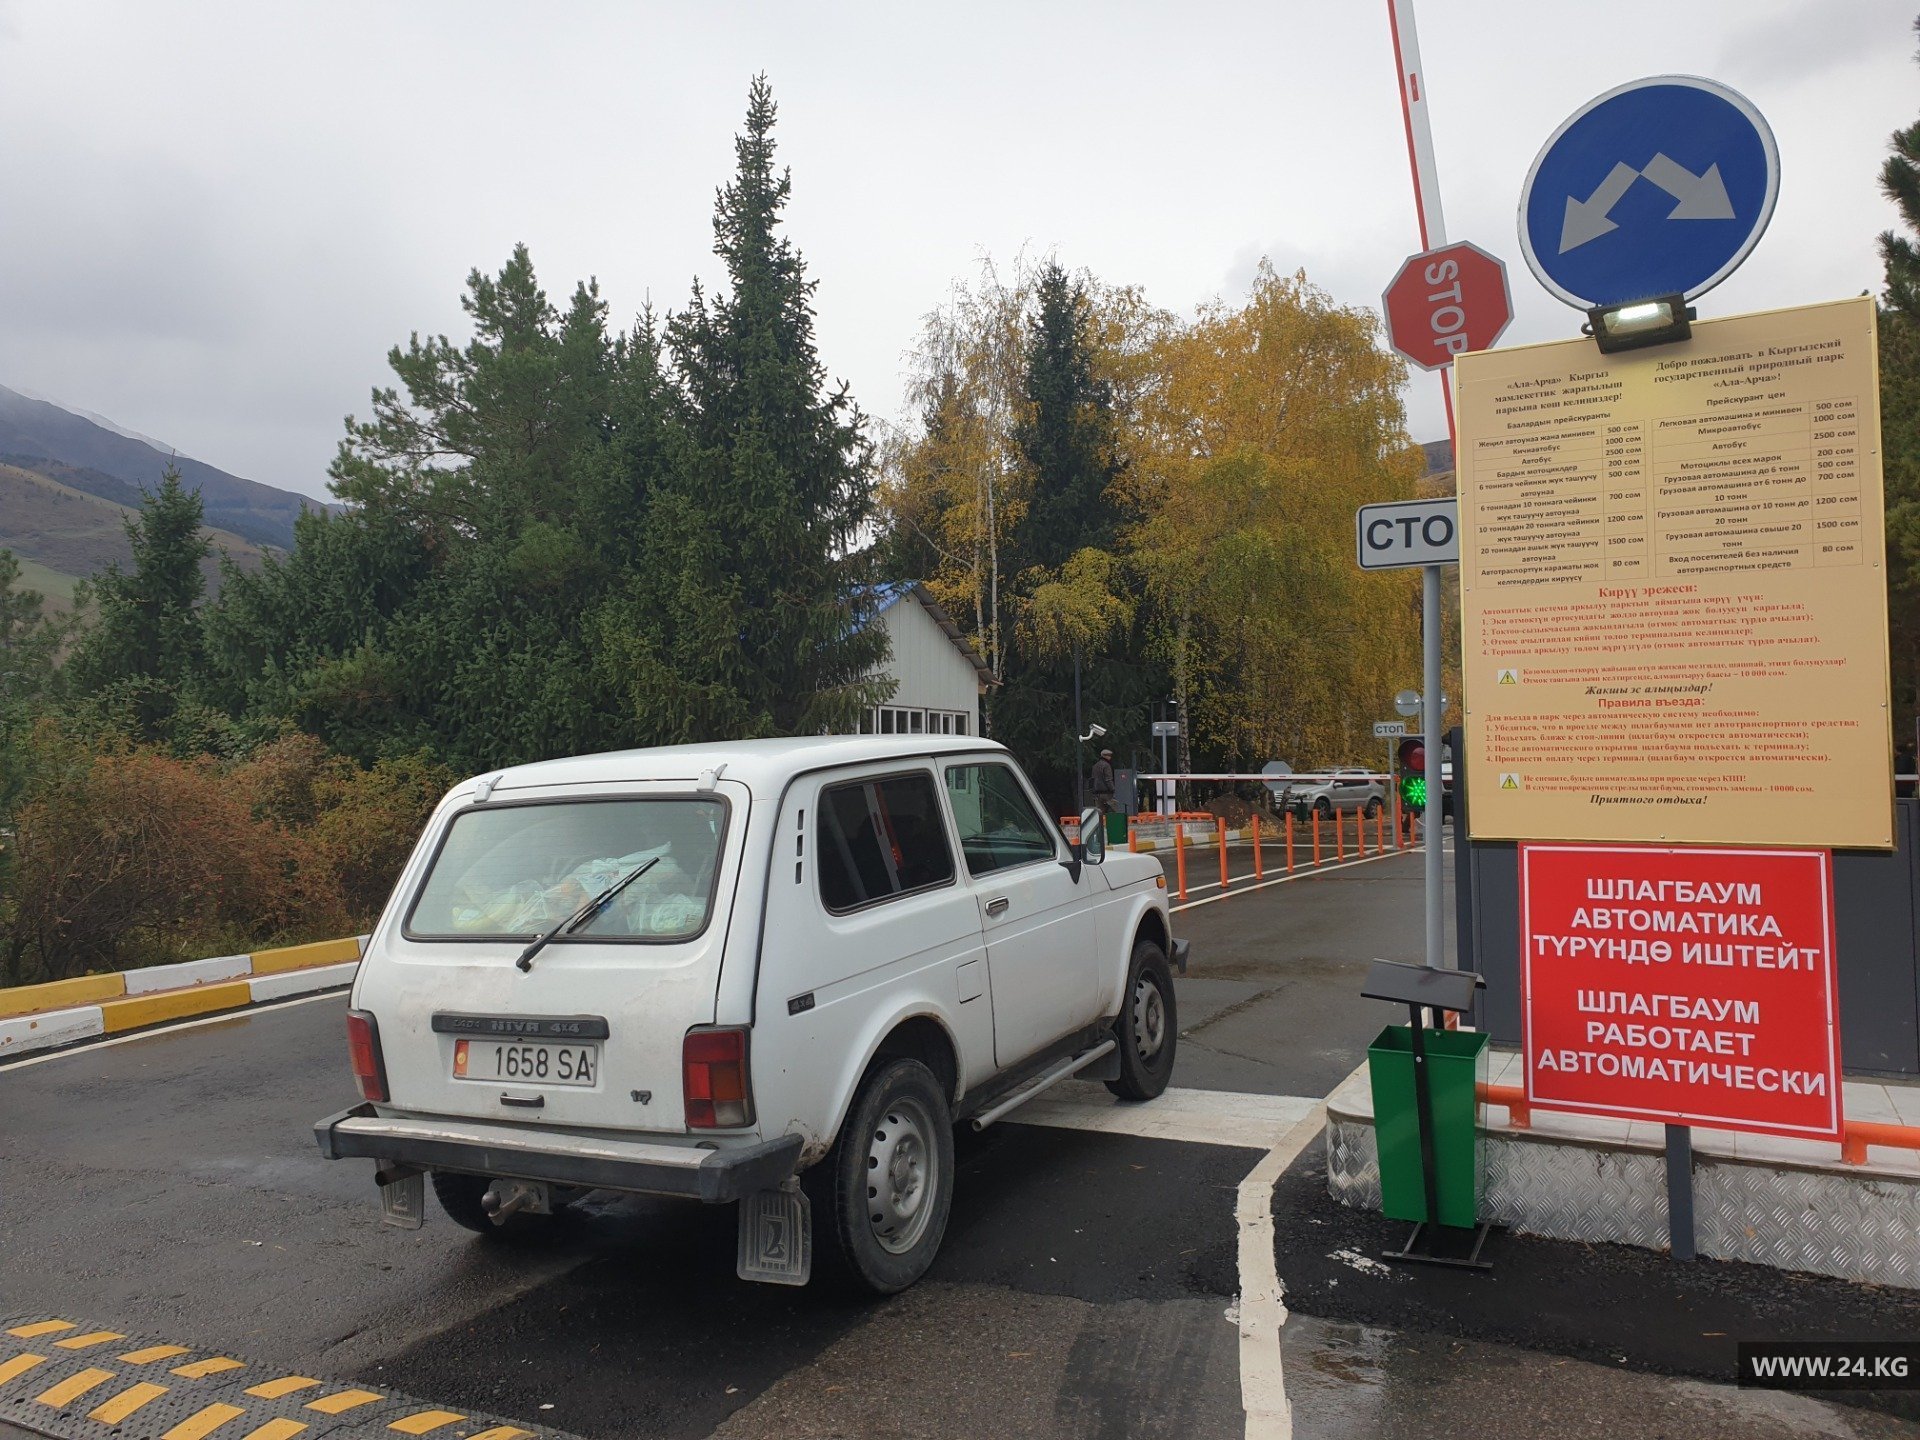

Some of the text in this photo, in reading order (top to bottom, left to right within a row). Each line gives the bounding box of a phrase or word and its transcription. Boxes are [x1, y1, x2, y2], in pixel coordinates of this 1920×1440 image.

[1424, 259, 1468, 354] STOP
[1706, 392, 1785, 407] Прейскурант цен
[1815, 402, 1832, 410] 500
[1813, 412, 1855, 422] 1000 сом
[1607, 425, 1622, 434] 500
[1813, 431, 1835, 440] 2500
[1605, 436, 1624, 445] 1000
[1712, 440, 1747, 450] Автобус
[1605, 448, 1624, 456] 2500
[1817, 448, 1833, 459] 200
[1521, 456, 1552, 465] Автобус
[1608, 459, 1622, 467] 200
[1817, 460, 1834, 469] 500
[1608, 470, 1623, 478] 500
[1818, 472, 1834, 480] 700
[1609, 492, 1623, 500] 700
[1714, 494, 1725, 502] 10
[1816, 496, 1837, 505] 1200
[1607, 514, 1626, 523] 1200
[1715, 517, 1726, 525] 20
[1816, 520, 1838, 529] 1500
[1366, 515, 1454, 550] СТО
[1608, 537, 1626, 545] 1500
[1822, 545, 1833, 553] 80
[1598, 698, 1705, 710] Правила въезда:
[1376, 725, 1404, 734] СТОП
[1590, 794, 1708, 806] Приятного отдыха!
[1587, 878, 1760, 905] ШЛАГБАУМ
[1571, 907, 1782, 937] АВТОМАТИКА
[1533, 935, 1820, 971] ТҮРҮНДӨ ИШТЕЙТ
[1578, 990, 1759, 1024] ШЛАГБАУМ
[491, 1021, 541, 1032] NIVA
[1587, 1022, 1755, 1056] РАБОТАЕТ
[495, 1046, 591, 1081] 1658 SA
[1538, 1048, 1825, 1096] АВТОМАТИЧЕСКИ
